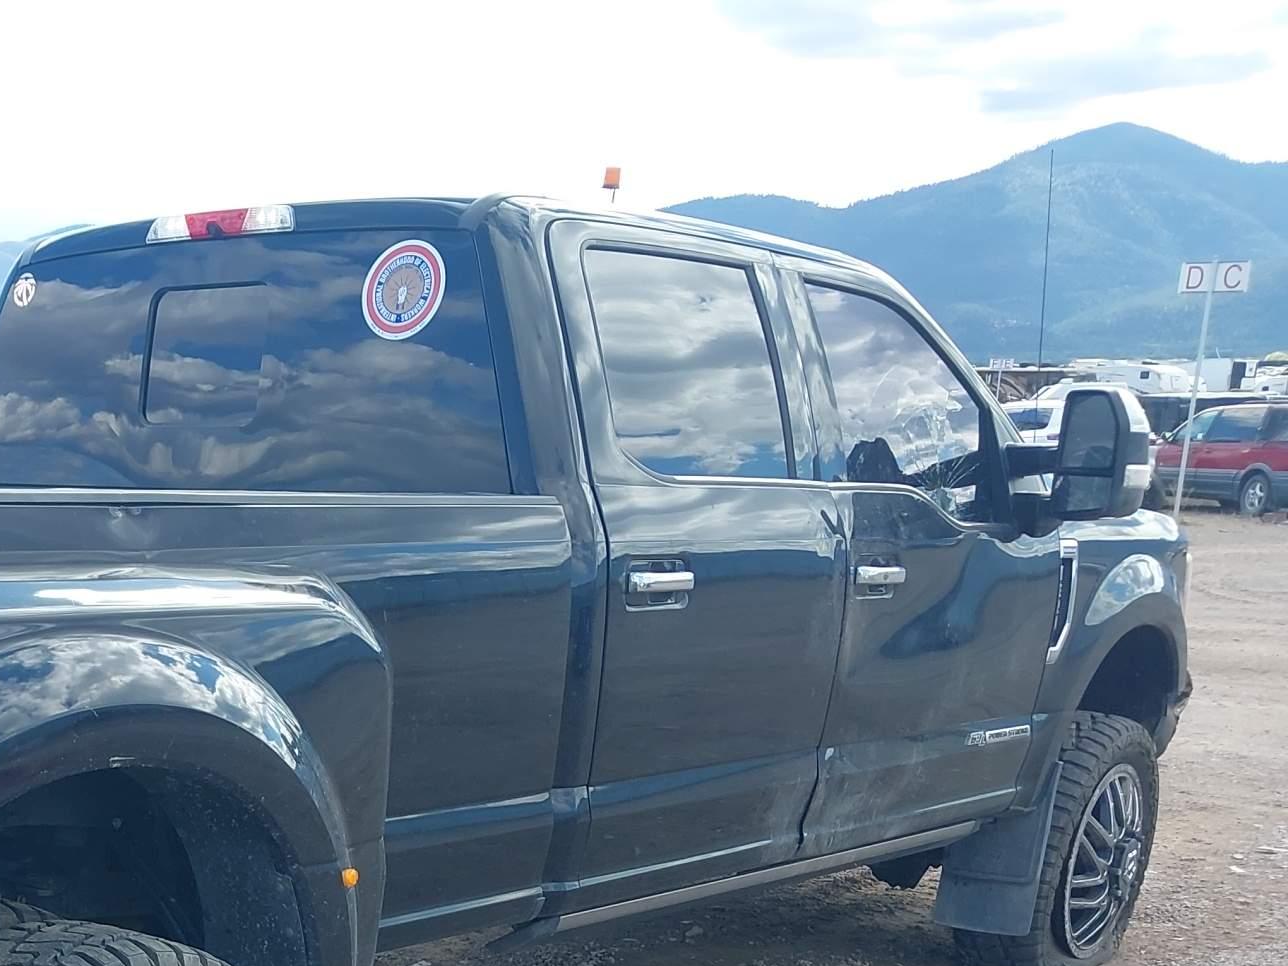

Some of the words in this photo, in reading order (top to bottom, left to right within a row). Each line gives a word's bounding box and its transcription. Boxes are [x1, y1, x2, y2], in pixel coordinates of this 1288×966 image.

[380, 255, 415, 284] BROTHERHOOD
[420, 261, 433, 300] ELECTRICAL
[1185, 265, 1204, 290] D
[1223, 264, 1243, 290] C
[400, 298, 427, 323] WORKERS
